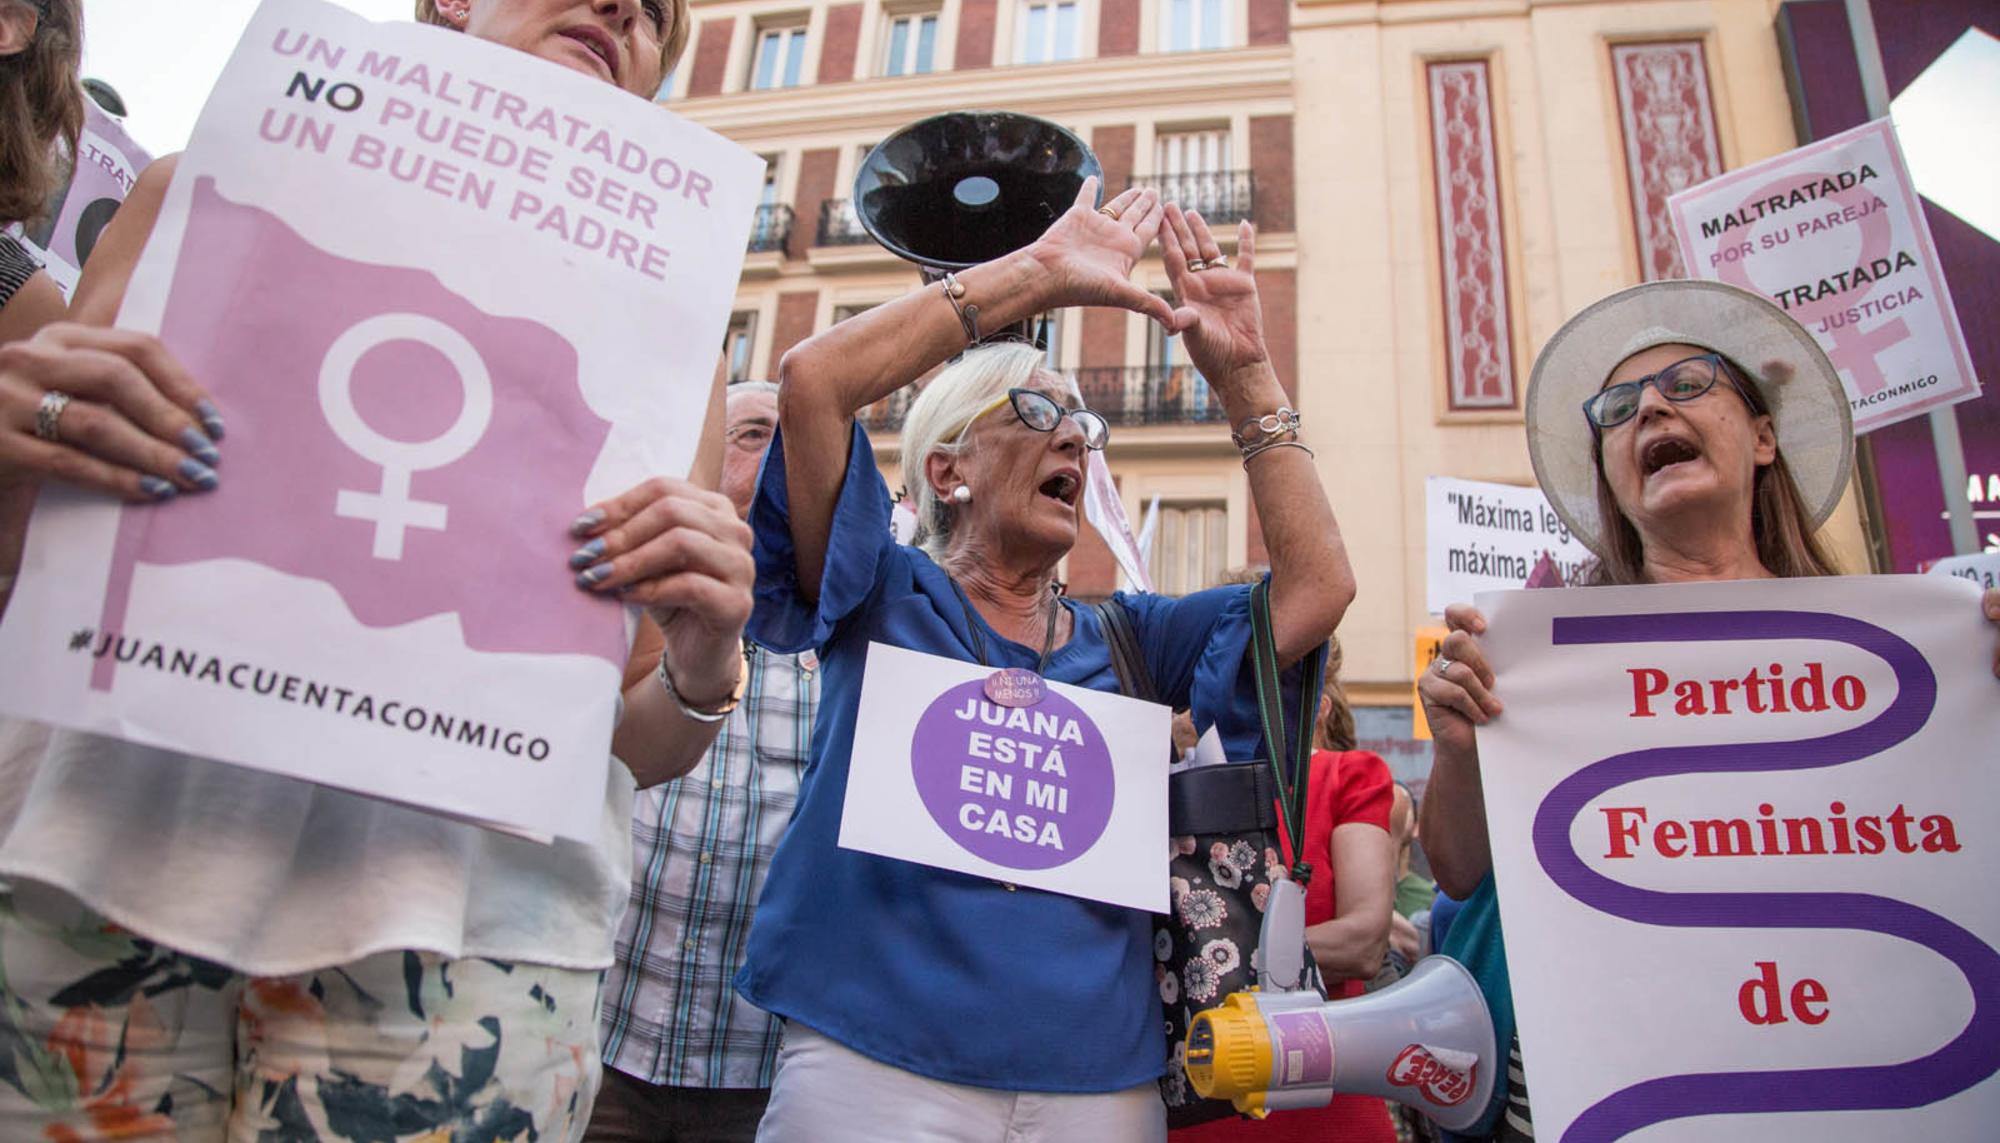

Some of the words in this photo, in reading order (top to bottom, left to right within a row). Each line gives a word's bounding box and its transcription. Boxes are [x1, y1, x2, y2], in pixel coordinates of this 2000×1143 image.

[271, 27, 346, 70] UN
[357, 50, 714, 208] MALTRATADOR
[284, 70, 365, 113] NO
[379, 97, 552, 184] PUEDE
[564, 170, 660, 230] SER
[258, 107, 336, 154] UN
[347, 133, 494, 210] BUEN
[508, 194, 672, 281] PADRE
[1701, 164, 1878, 239] MALTRATADA
[1710, 241, 1756, 268] POR
[1761, 228, 1790, 250] SU
[1797, 196, 1888, 238] PAREJA
[1775, 250, 1917, 310] TRATADA
[1818, 286, 1923, 333] JUSTICIA
[1448, 493, 1533, 532] "Máxima
[1449, 542, 1527, 580] máxima
[68, 629, 549, 763] #JUANACUENTACONMIGO
[1626, 663, 1867, 718] Partido
[955, 698, 1084, 746] JUANA
[968, 731, 1067, 778] ESTÁ
[959, 764, 1011, 800] EN
[1026, 780, 1068, 815] MI
[958, 803, 1064, 851] CASA
[1599, 802, 1962, 860] Feminista
[1738, 961, 1830, 1026] de
